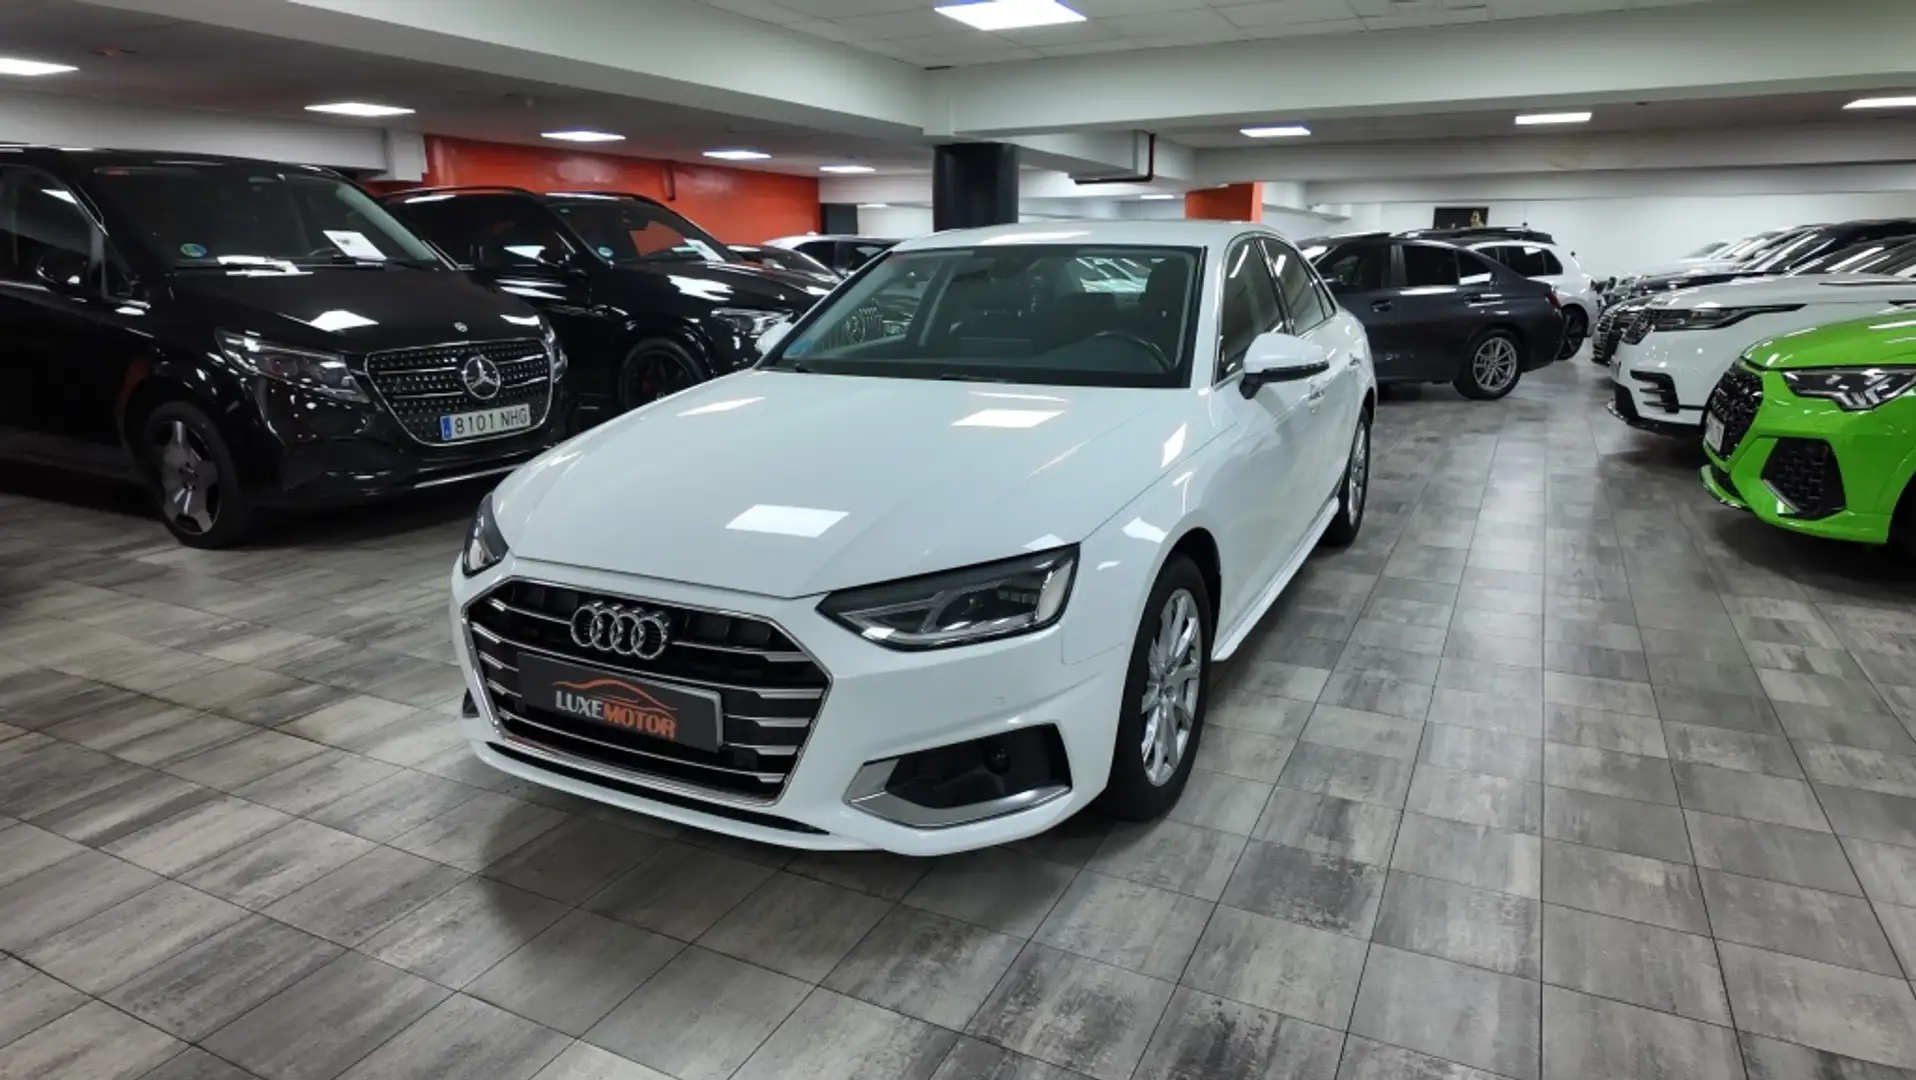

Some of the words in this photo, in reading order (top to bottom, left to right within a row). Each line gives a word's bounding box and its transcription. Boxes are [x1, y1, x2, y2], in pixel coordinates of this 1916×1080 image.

[454, 412, 494, 435] 8101
[501, 407, 528, 427] NHG
[556, 690, 676, 739] LUXEMOTOR
